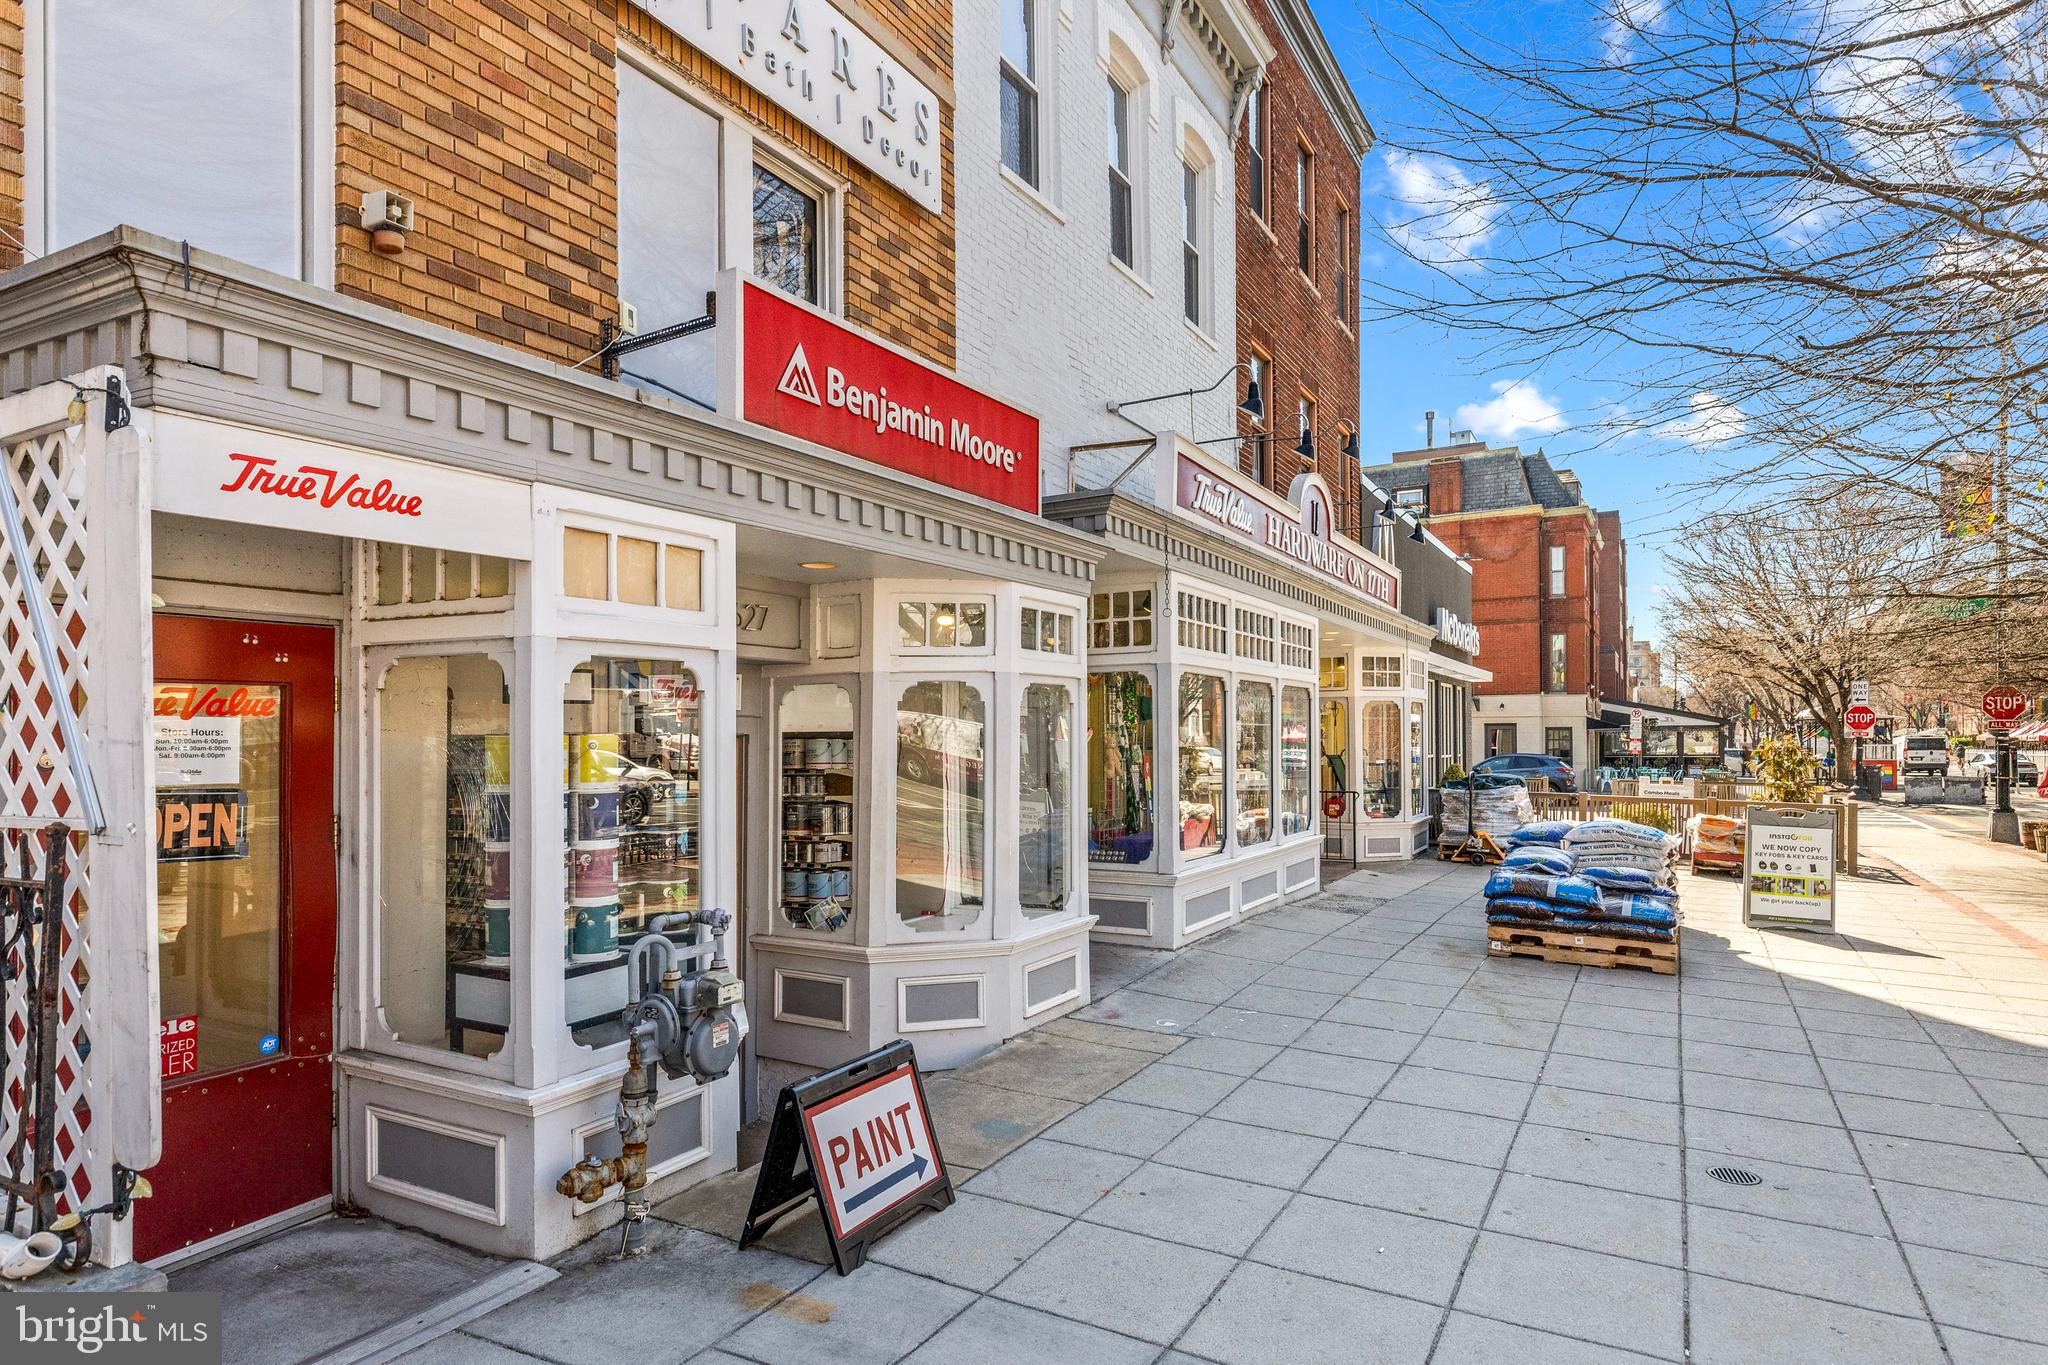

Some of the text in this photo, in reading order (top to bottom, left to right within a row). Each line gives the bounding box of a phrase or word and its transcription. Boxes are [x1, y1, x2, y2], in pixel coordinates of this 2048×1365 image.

[741, 23, 932, 186] Bath Decor
[826, 366, 1015, 474] Benjamin Moore
[1265, 513, 1389, 602] HARDWARE ON 17TH
[1847, 713, 1874, 723] STOP
[1985, 696, 2023, 710] STOP
[191, 728, 224, 737] Hours:
[262, 1038, 277, 1049] ADT
[828, 1101, 911, 1190] PAINT
